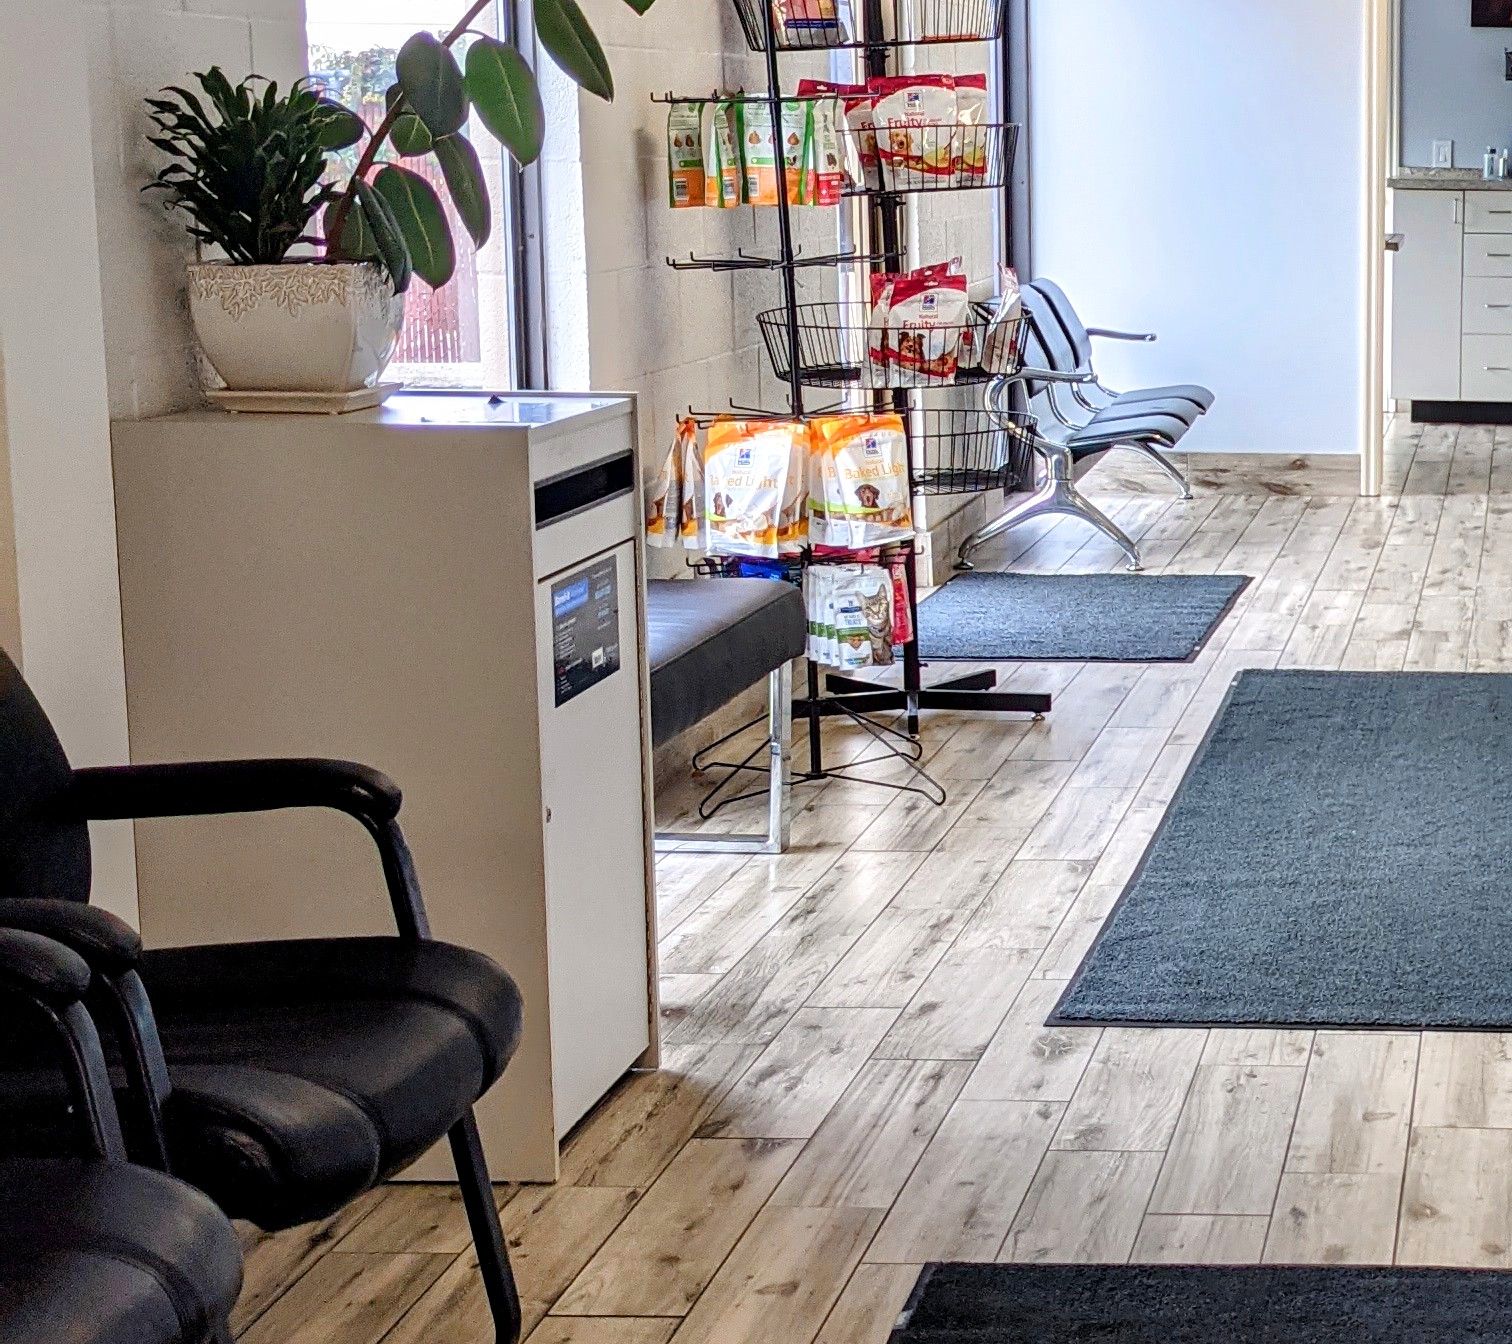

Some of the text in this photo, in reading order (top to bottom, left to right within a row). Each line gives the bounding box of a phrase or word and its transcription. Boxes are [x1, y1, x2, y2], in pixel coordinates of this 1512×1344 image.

[902, 319, 936, 333] Fruity
[844, 467, 880, 480] Baked
[709, 474, 742, 488] Baed
